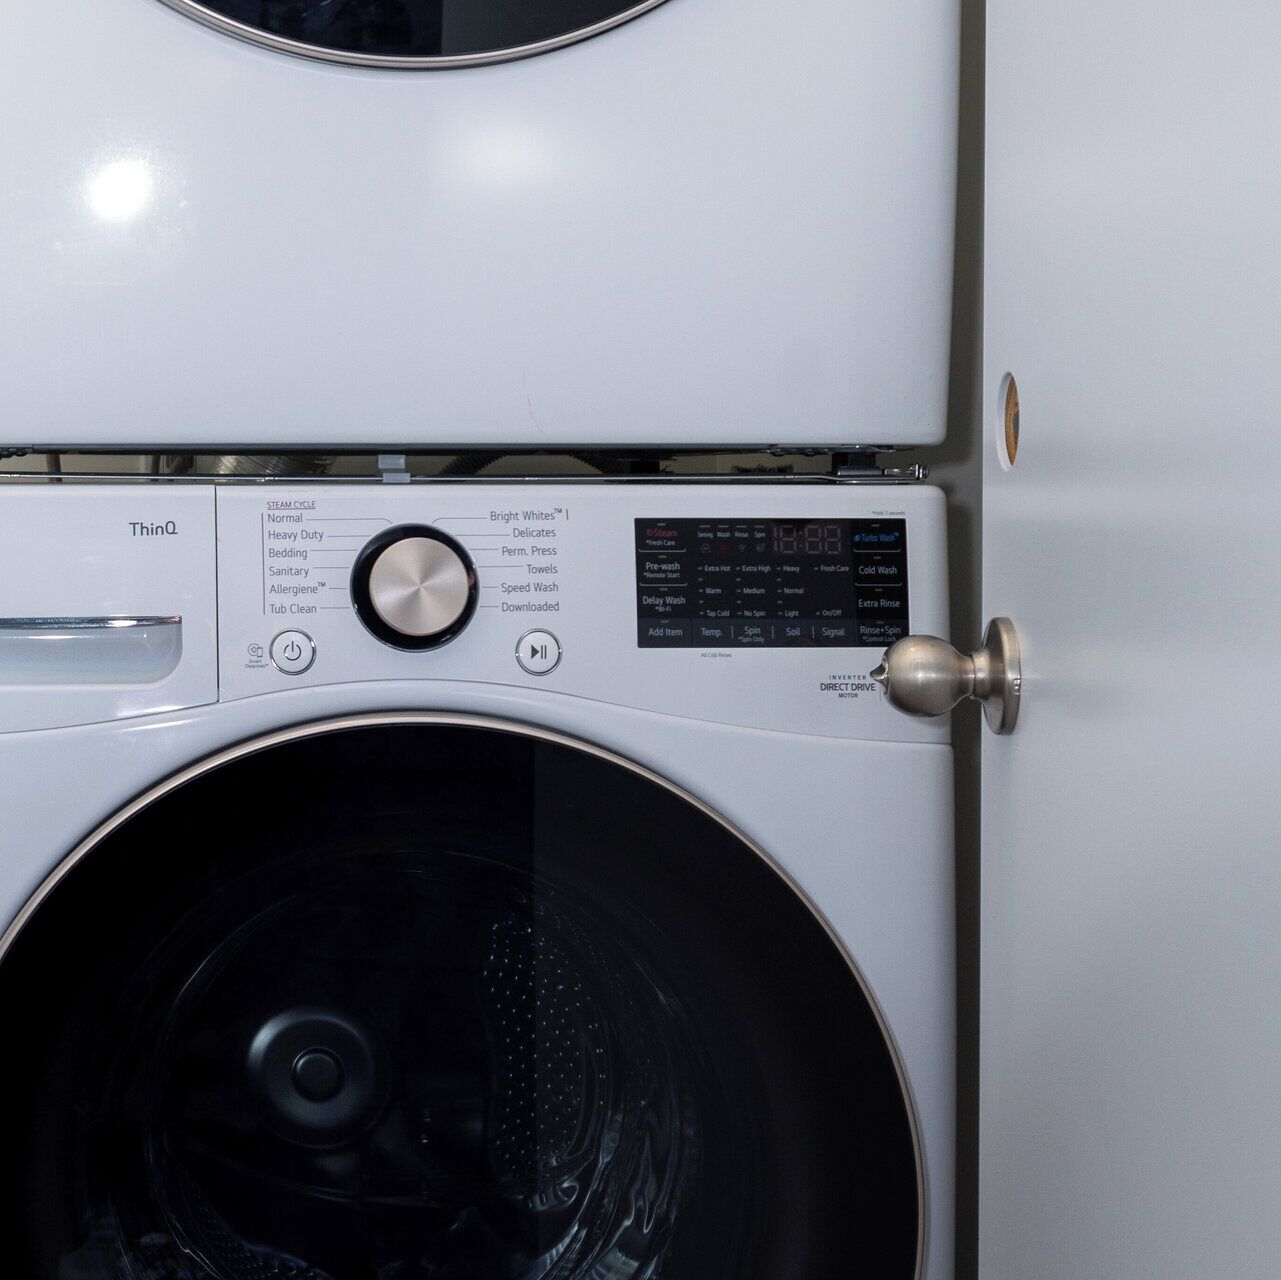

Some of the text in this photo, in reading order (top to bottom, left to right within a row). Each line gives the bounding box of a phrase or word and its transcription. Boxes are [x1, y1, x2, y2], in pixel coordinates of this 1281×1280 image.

[268, 514, 303, 523] Normal
[490, 511, 519, 523] Bright
[129, 521, 178, 536] ThinQ
[513, 528, 556, 538] Delicates
[268, 530, 324, 542] Heavy Duty
[862, 534, 878, 542] Turbo
[269, 548, 308, 560] Bedding
[502, 546, 557, 556] Perm. Press
[527, 564, 558, 574] Towels
[646, 562, 680, 571] Pre-wash
[758, 565, 771, 573] High
[783, 565, 800, 573] Heavy
[859, 566, 897, 574] Cold Wash
[269, 566, 309, 578] Sanitary
[501, 582, 558, 595] Speed Wash
[642, 596, 686, 606] Delay Wash
[858, 599, 900, 608] Extra Rinse
[270, 604, 317, 614] Tub Clean
[502, 602, 559, 612] Downloaded
[649, 628, 683, 636] Add Item
[701, 628, 723, 637] Temp.
[744, 626, 761, 635] Spin
[786, 627, 800, 636] Soil
[822, 628, 845, 637] Signal
[860, 626, 901, 635] Rinse+Spin
[820, 683, 876, 691] DIRECT DRIVE
